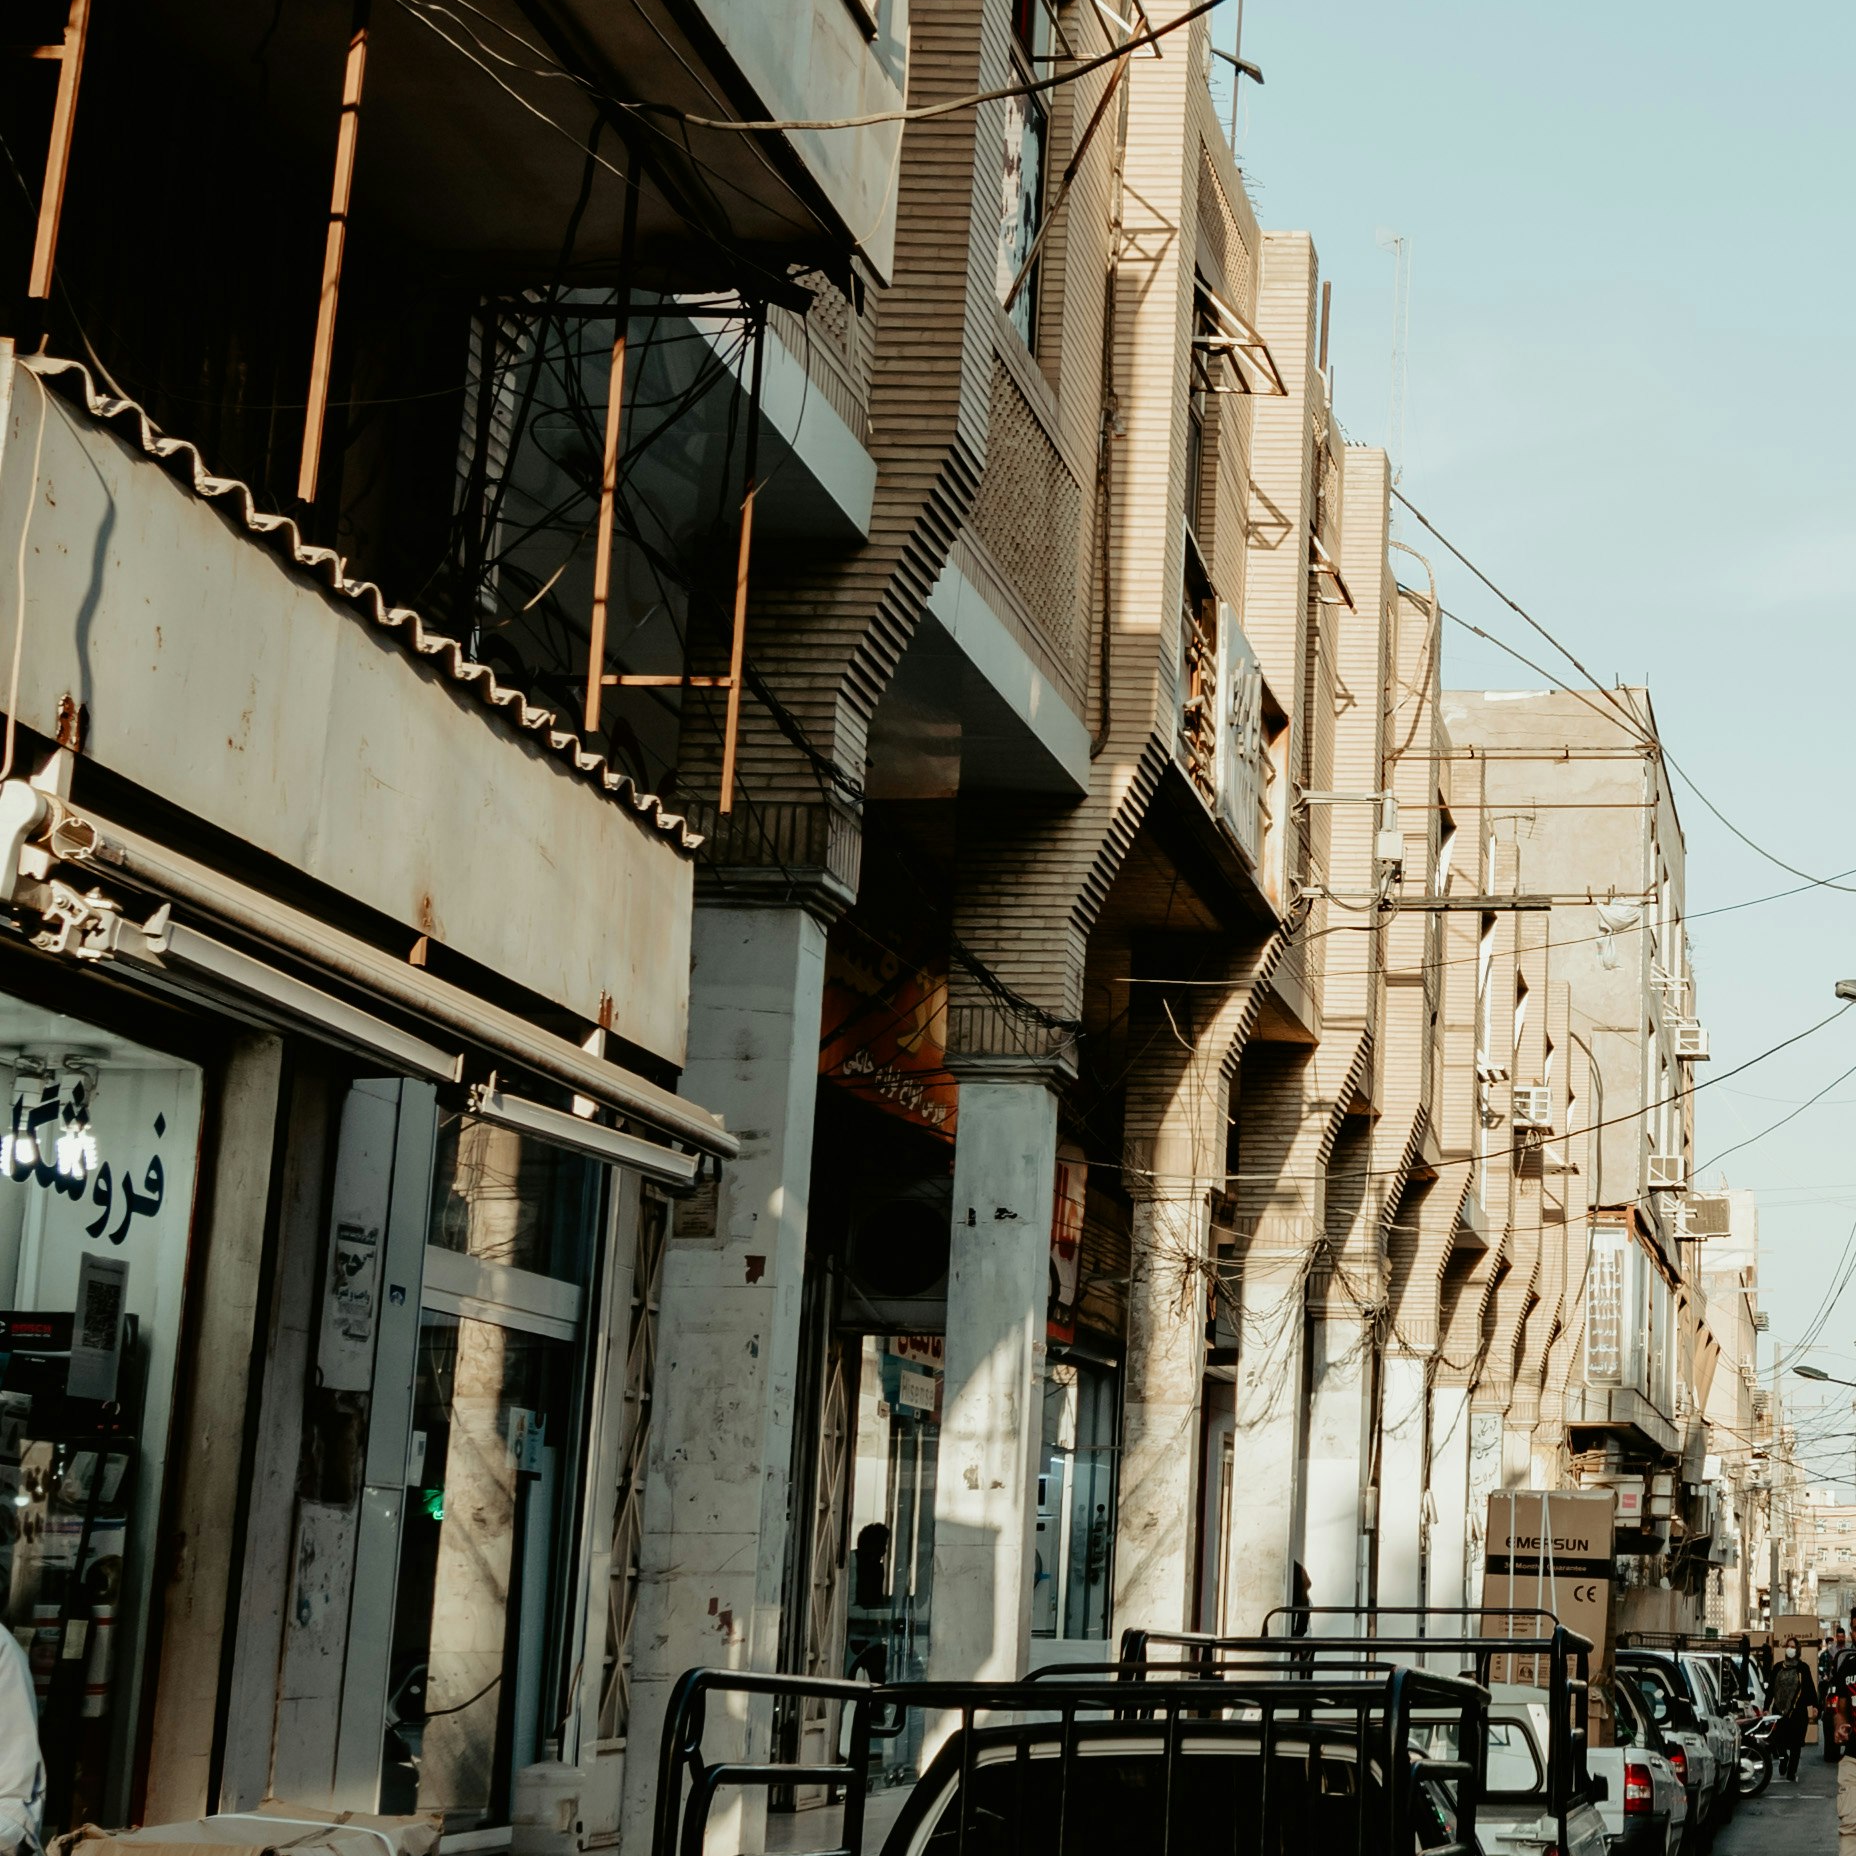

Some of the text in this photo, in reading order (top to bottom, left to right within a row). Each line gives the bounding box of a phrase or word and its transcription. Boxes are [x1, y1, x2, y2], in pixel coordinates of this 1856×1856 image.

[0, 1080, 167, 1245] فروشگا
[1516, 1562, 1542, 1570] Month
[1574, 1585, 1597, 1603] CE
